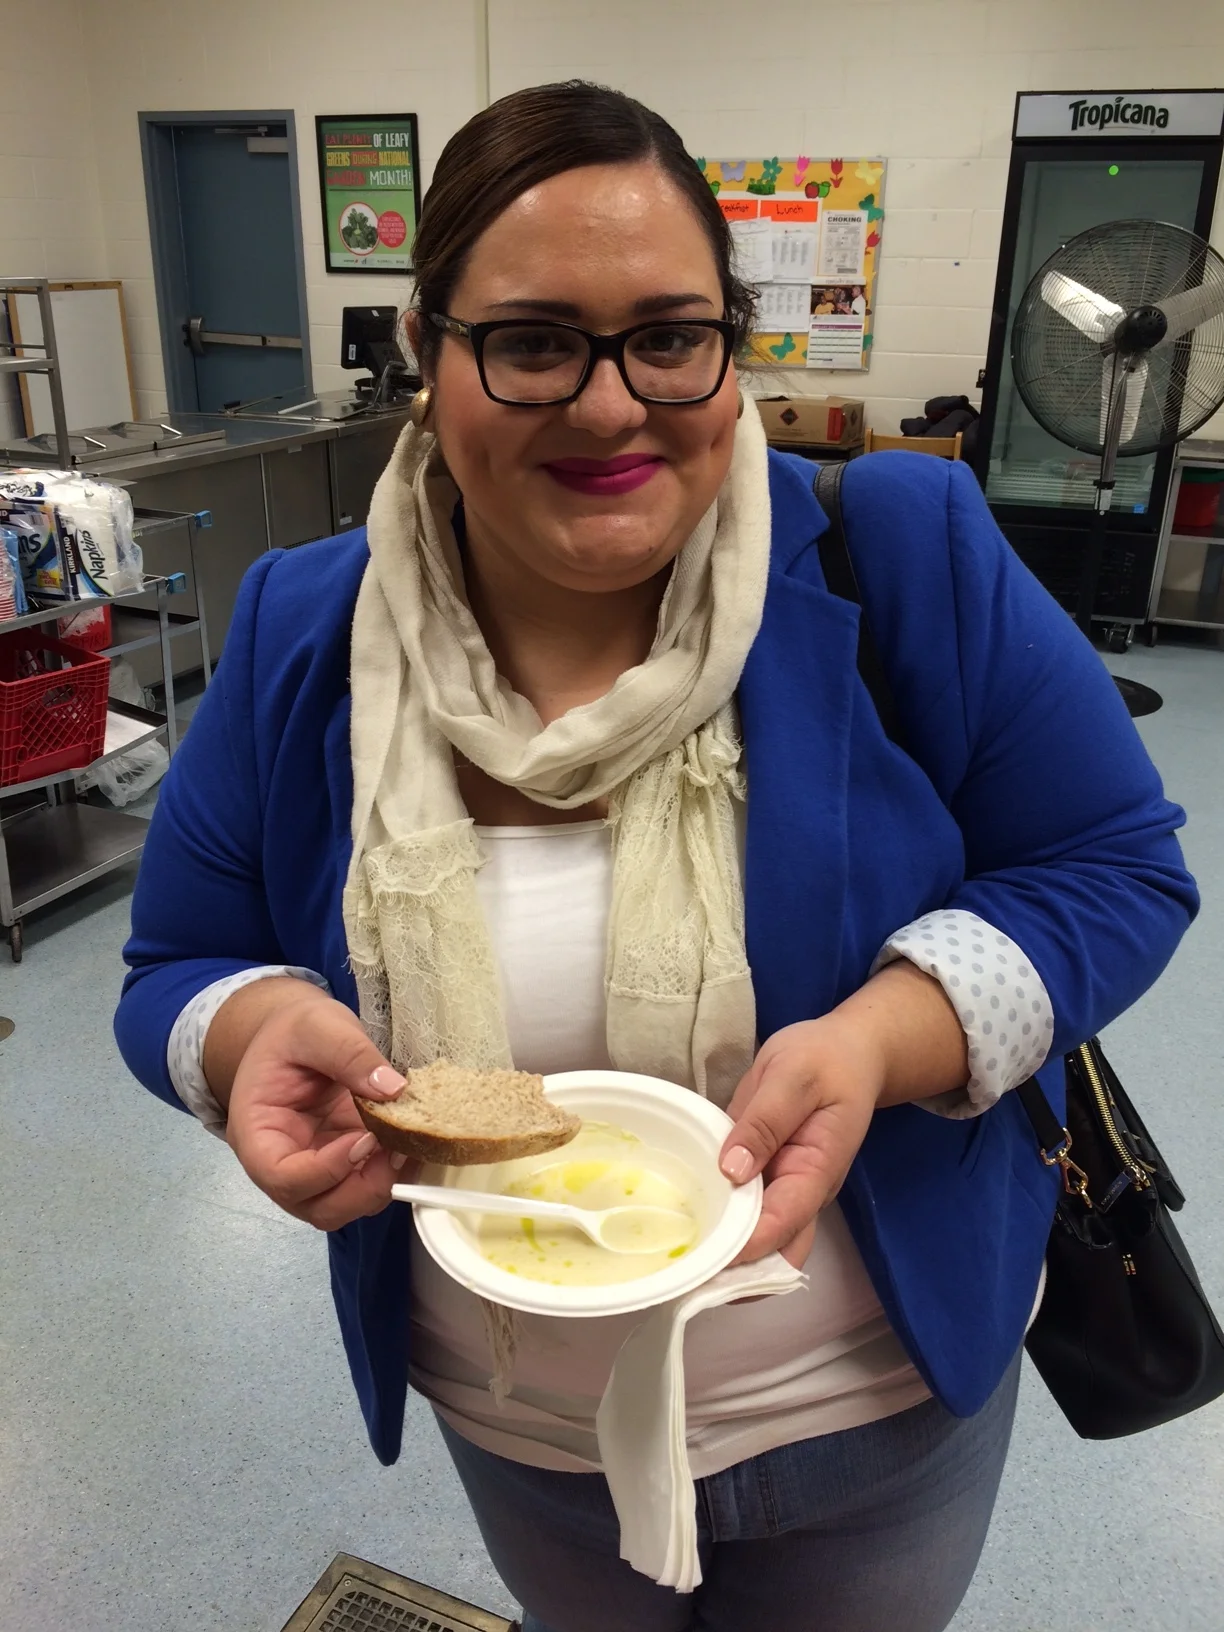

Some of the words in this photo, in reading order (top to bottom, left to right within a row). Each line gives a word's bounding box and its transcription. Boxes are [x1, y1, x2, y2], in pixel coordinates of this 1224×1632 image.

[1069, 96, 1169, 131] Tropicana
[373, 133, 383, 148] OF
[385, 132, 410, 147] LEAFY
[326, 152, 350, 167] GREENS
[353, 153, 377, 165] DURING
[369, 169, 412, 186] MONTH!
[776, 203, 804, 216] Lunch
[64, 536, 75, 574] KIRKLAND
[79, 528, 108, 580] Napkins
